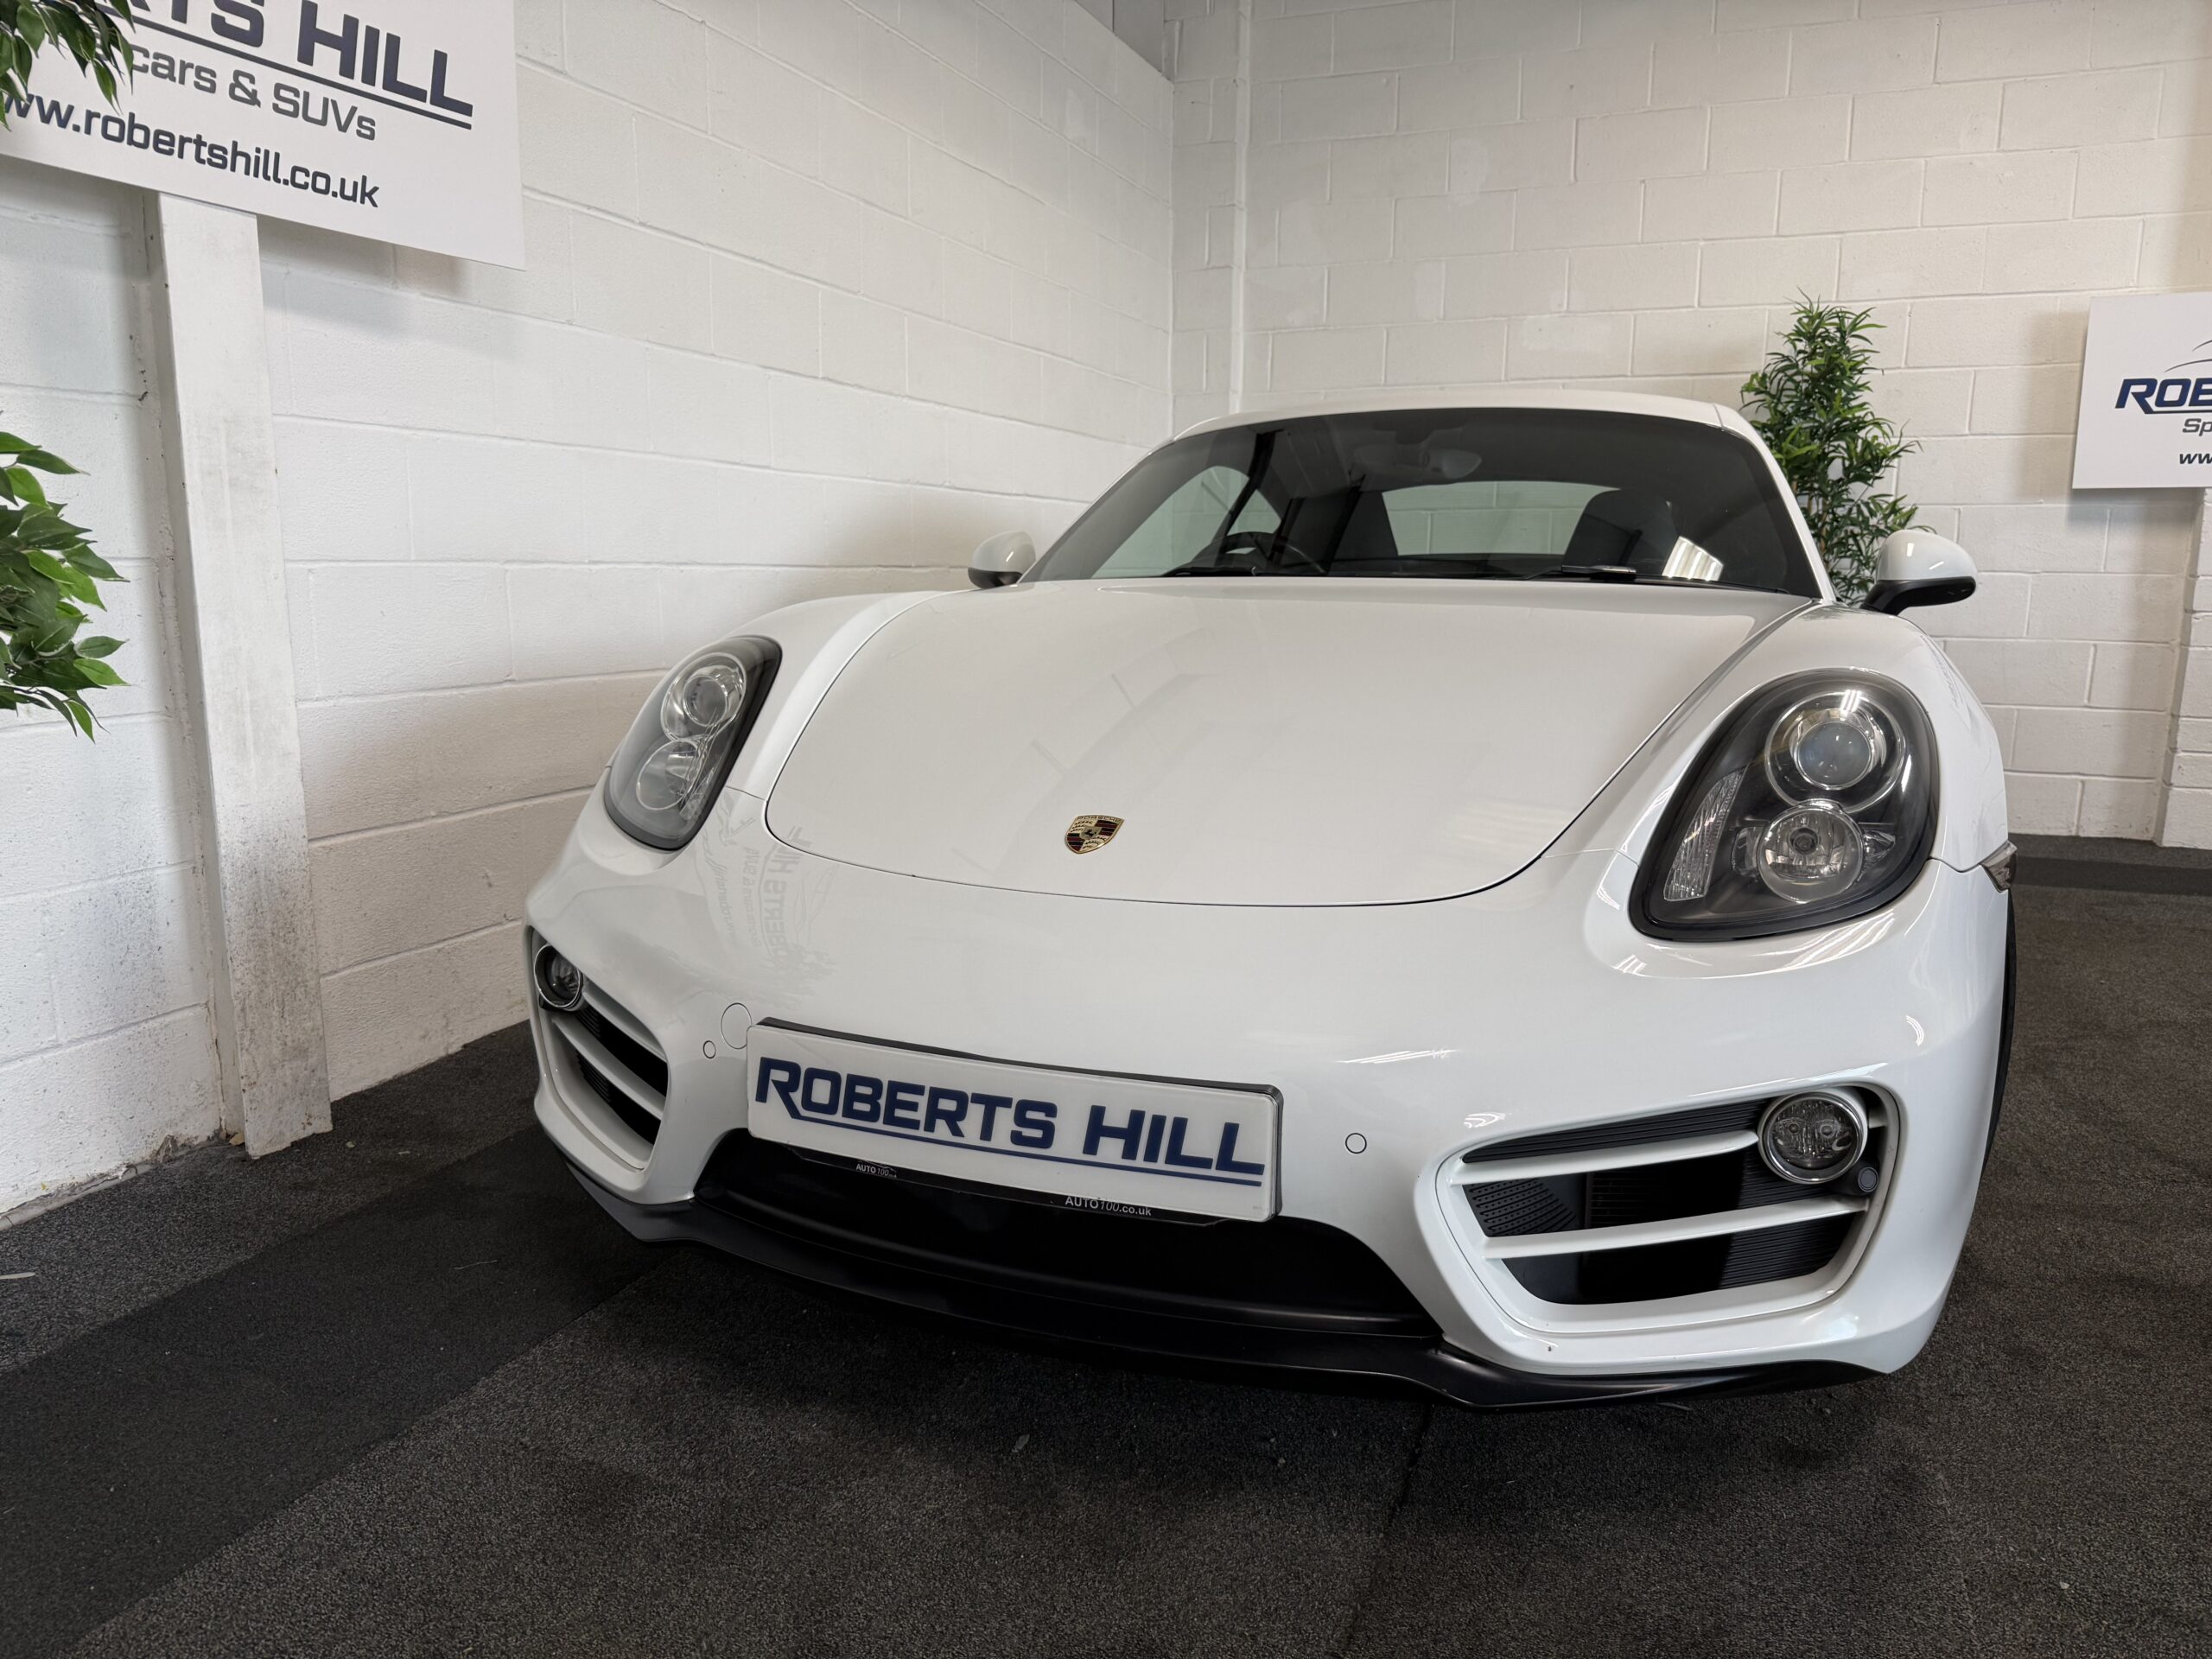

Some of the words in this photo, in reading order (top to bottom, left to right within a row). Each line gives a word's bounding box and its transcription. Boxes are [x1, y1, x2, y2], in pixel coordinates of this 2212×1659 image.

[228, 70, 261, 107] &
[271, 83, 377, 141] SUVs
[297, 0, 474, 118] HILL
[755, 1056, 1058, 1149] ROBERTS
[1083, 1104, 1265, 1176] HILL
[1065, 1196, 1152, 1217] AUTO100.co.uk
